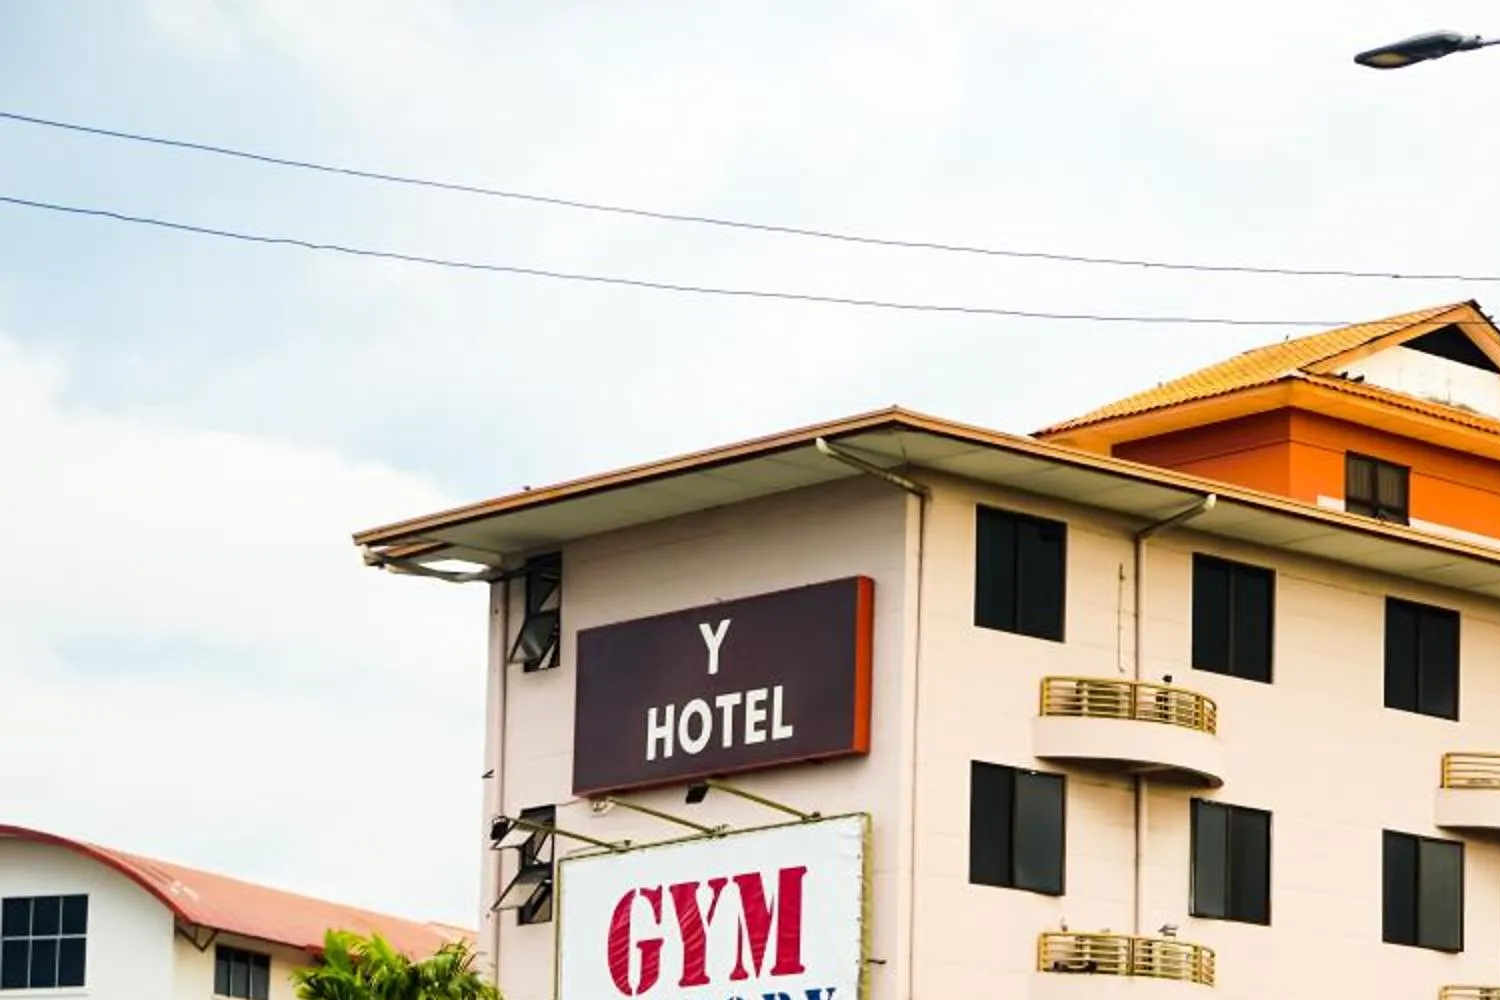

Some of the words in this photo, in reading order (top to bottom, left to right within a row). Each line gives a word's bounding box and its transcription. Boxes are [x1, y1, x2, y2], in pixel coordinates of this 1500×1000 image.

[699, 619, 731, 675] Y
[645, 685, 793, 761] HOTEL
[607, 865, 808, 998] GYM
